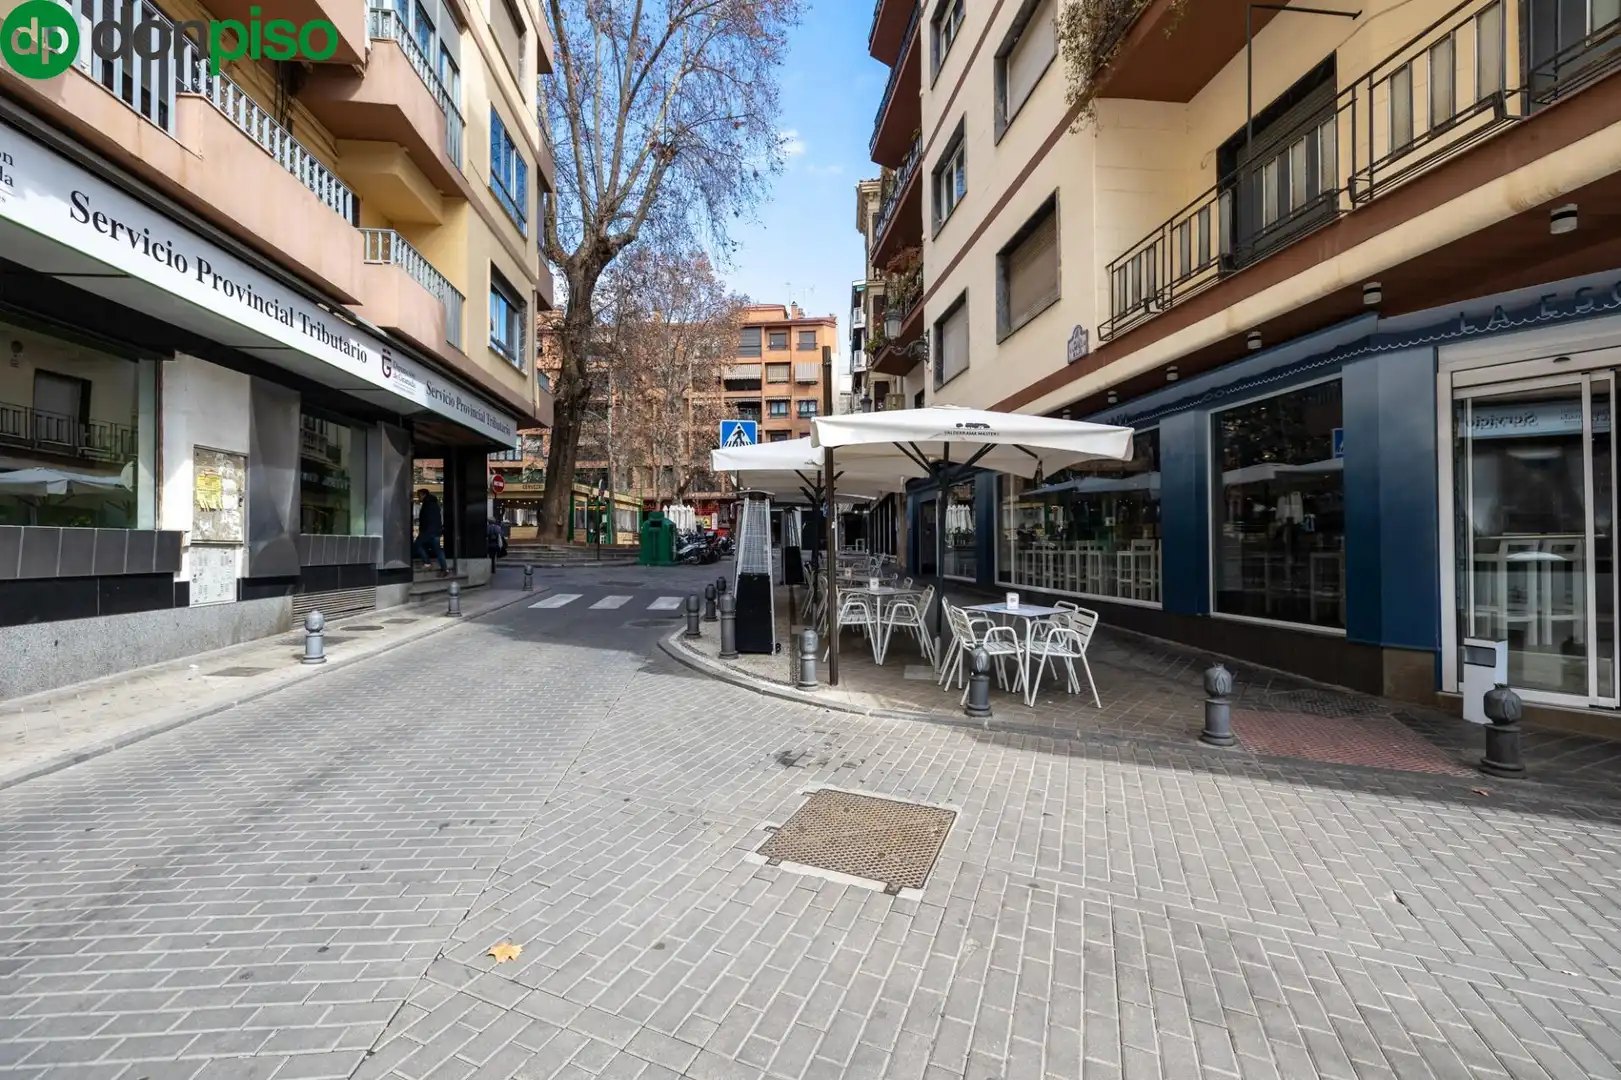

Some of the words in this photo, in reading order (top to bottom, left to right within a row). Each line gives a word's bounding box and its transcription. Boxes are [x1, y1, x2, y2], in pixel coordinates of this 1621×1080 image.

[70, 190, 188, 274] Servicio
[196, 256, 294, 328] Provincial
[299, 312, 367, 364] Tributario
[1460, 304, 1510, 332] LA
[426, 380, 455, 408] Servicio
[456, 397, 486, 423] Provincial
[486, 413, 511, 437] Tributario
